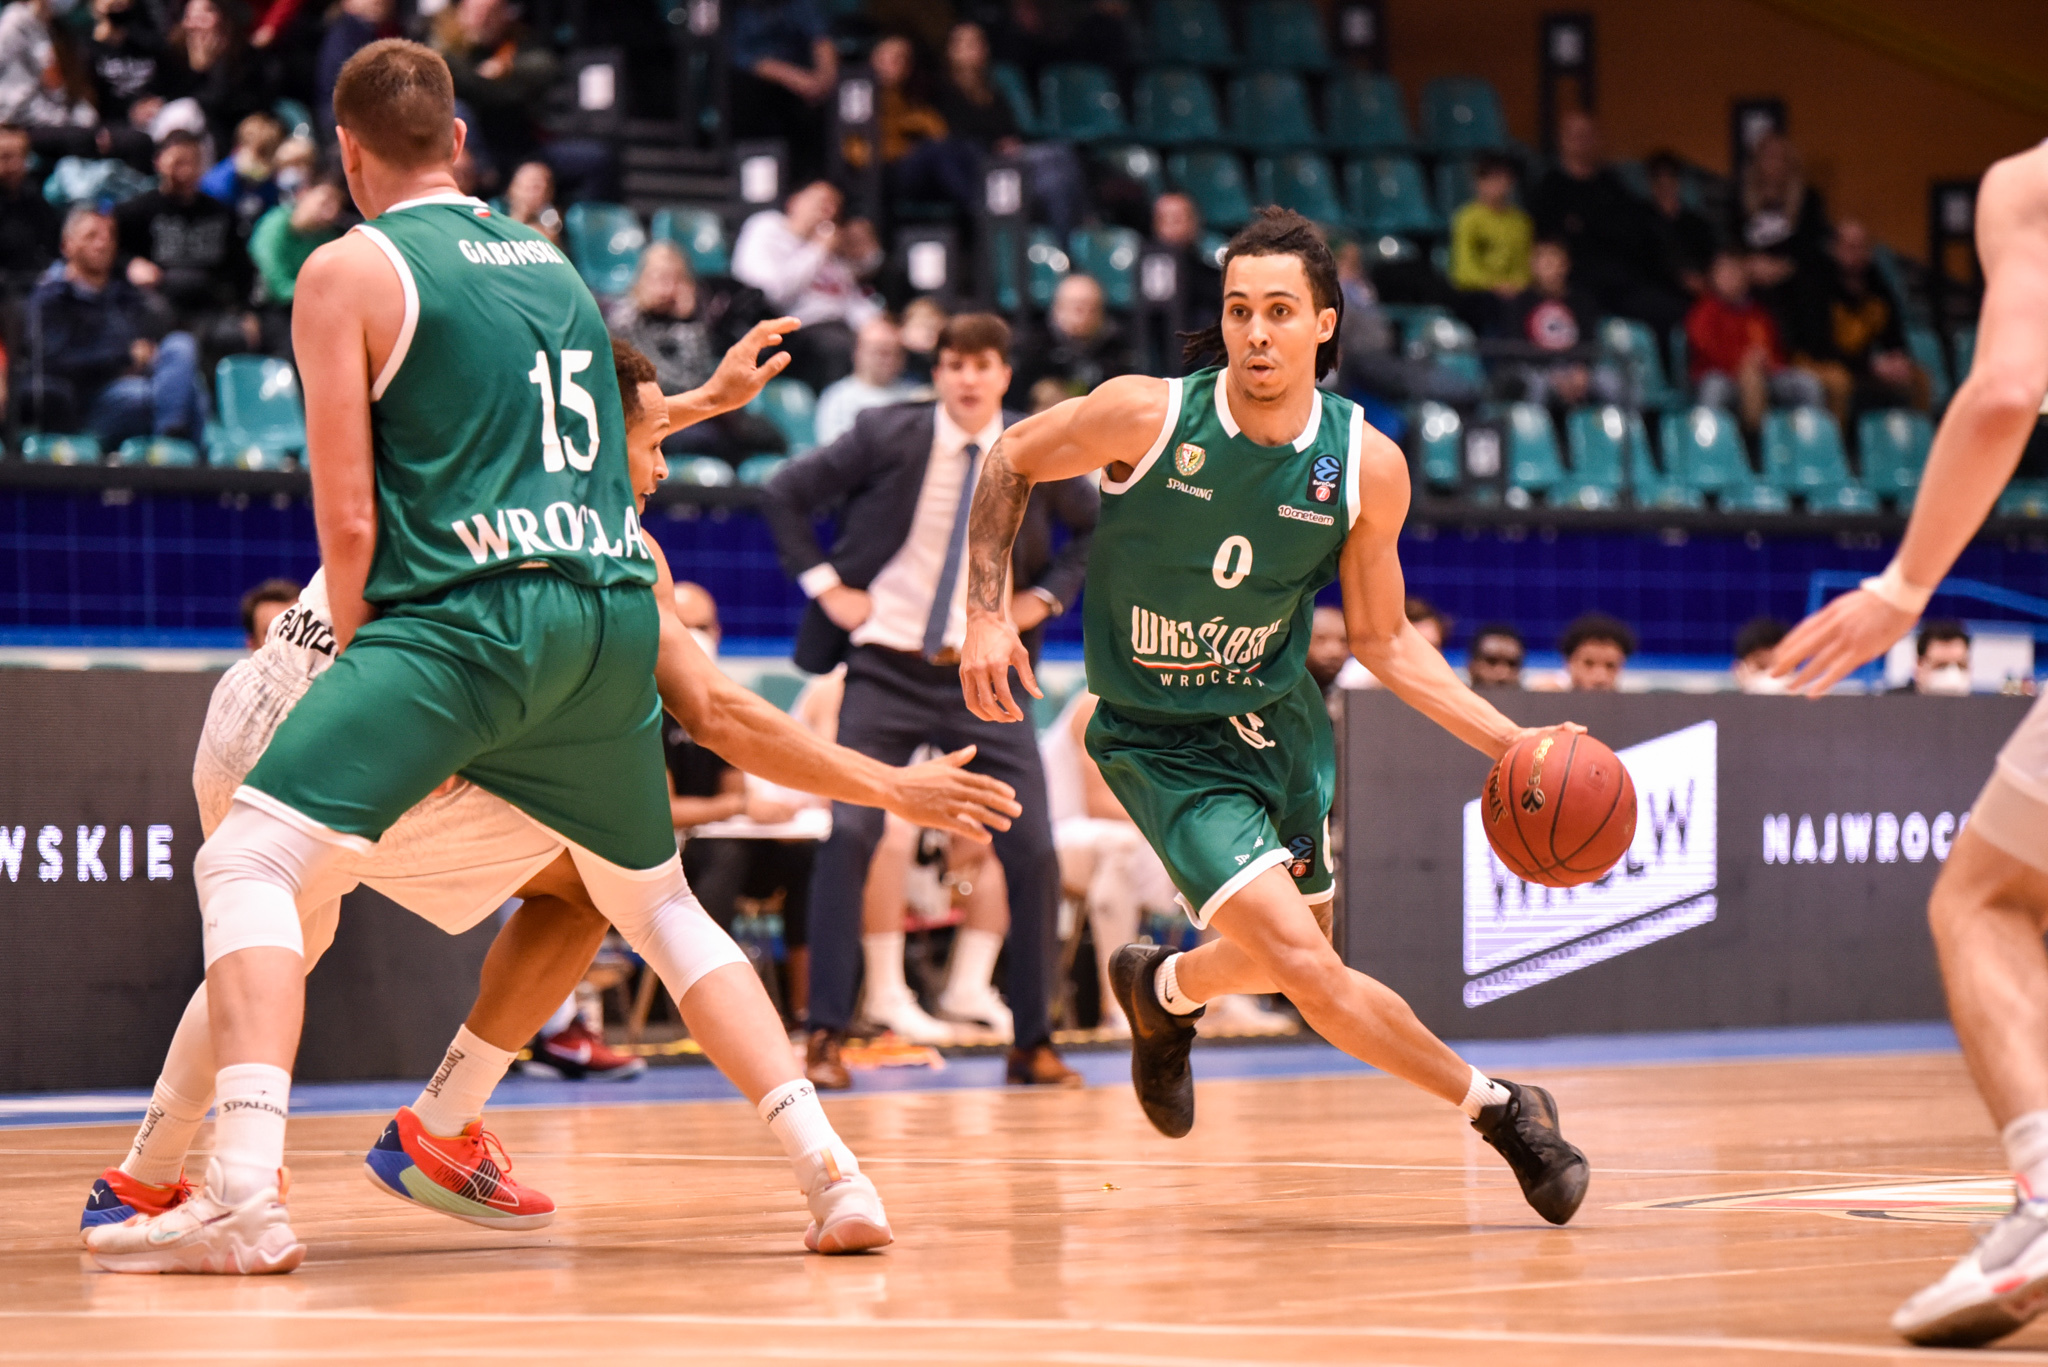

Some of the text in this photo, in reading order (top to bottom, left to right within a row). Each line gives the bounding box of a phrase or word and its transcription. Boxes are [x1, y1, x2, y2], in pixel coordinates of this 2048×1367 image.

[528, 350, 601, 472] 15
[1166, 477, 1214, 501] SPALDING
[1212, 534, 1253, 589] 0
[0, 824, 174, 883] WSKIE
[1762, 811, 1972, 865] NAJWROC
[426, 1045, 465, 1099] SPALDING
[134, 1101, 166, 1156] SPALDING
